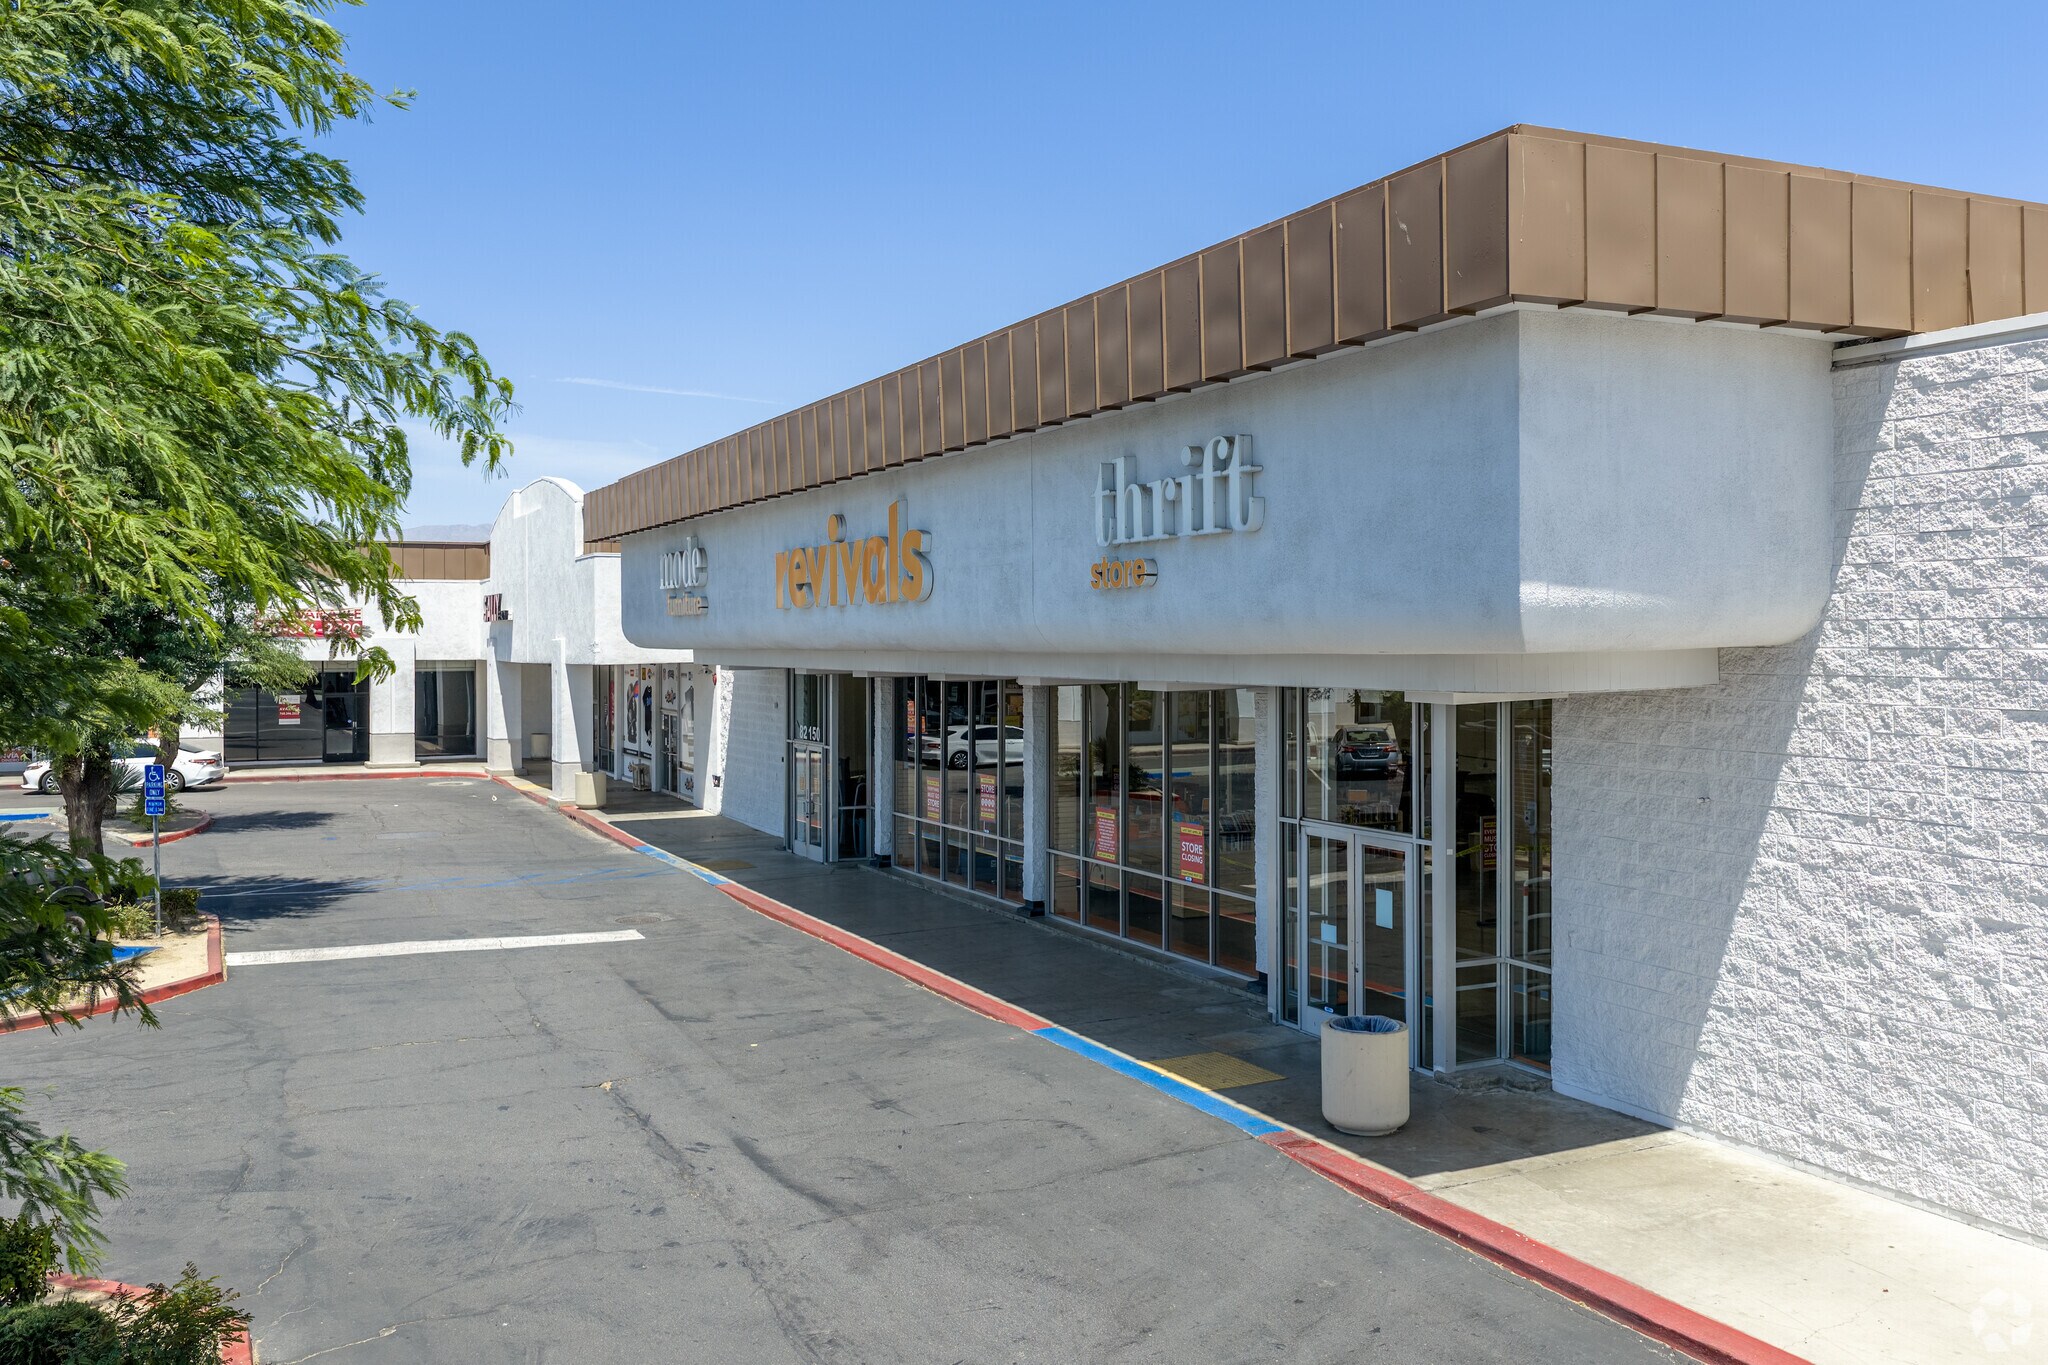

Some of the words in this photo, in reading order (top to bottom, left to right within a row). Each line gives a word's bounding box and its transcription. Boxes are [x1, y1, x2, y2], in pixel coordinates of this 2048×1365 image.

[1090, 434, 1265, 547] thrift
[660, 537, 708, 589] mode
[775, 499, 933, 609] revivals
[1090, 556, 1158, 590] store
[981, 784, 995, 794] STORE
[1182, 841, 1203, 855] STORE
[1182, 852, 1203, 864] CLOSING
